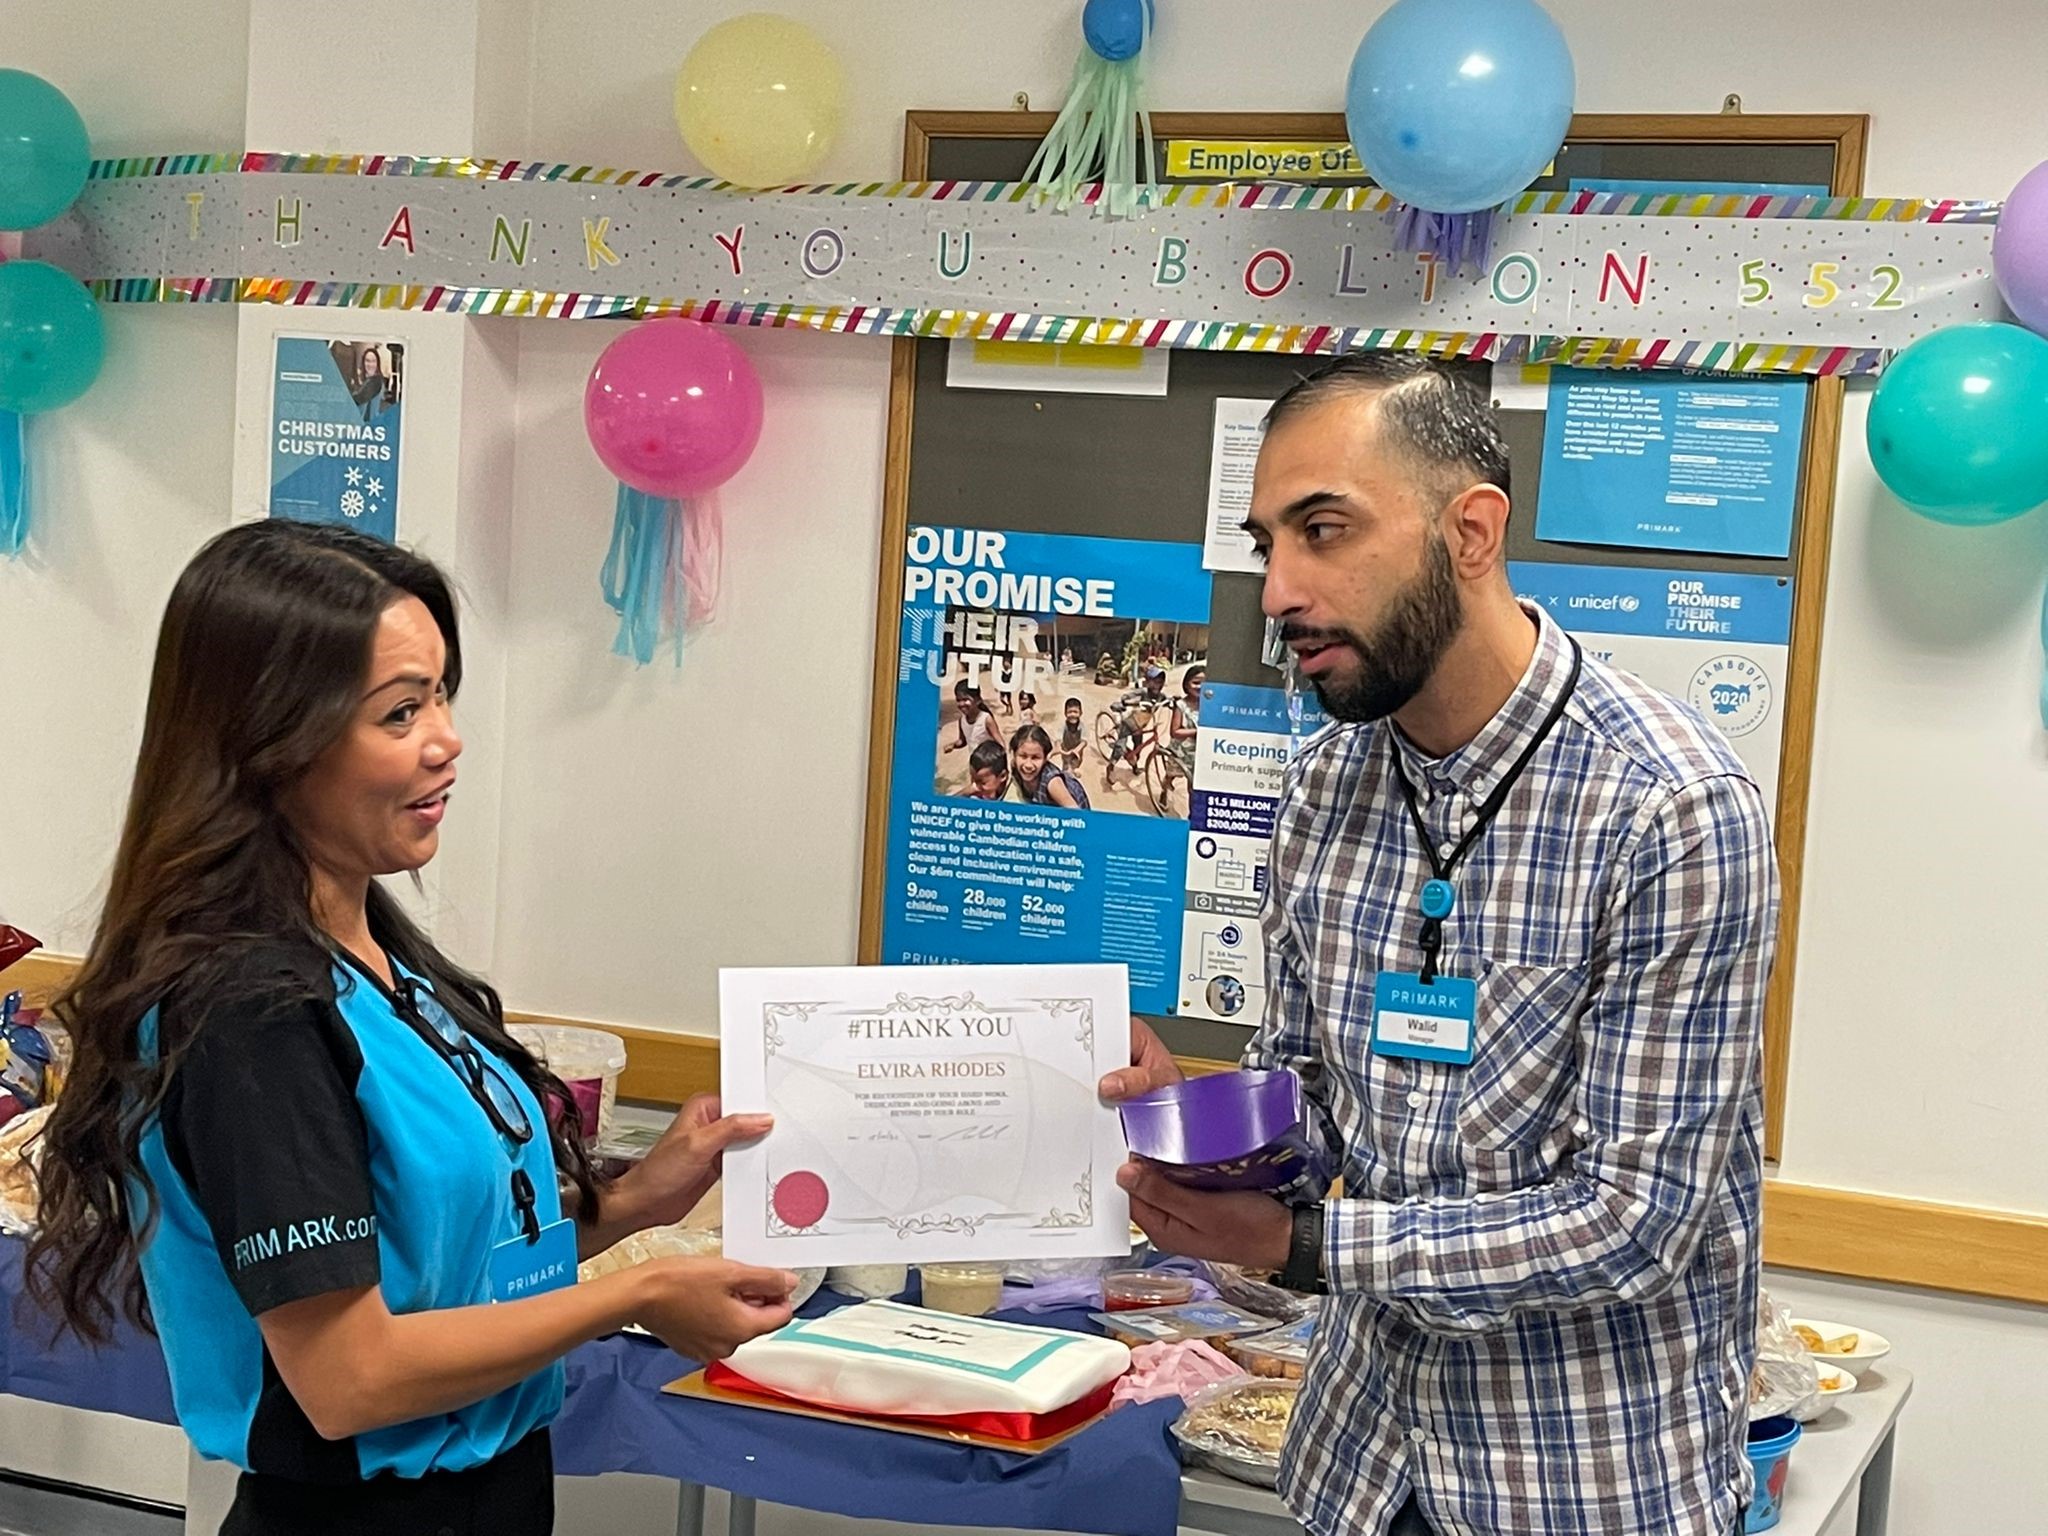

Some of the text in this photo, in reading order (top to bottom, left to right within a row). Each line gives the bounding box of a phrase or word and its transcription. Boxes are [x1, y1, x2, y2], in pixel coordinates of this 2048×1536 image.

[1189, 149, 1352, 176] Employee Of
[186, 192, 1904, 310] THANK YOU BOLTON 552
[278, 420, 386, 441] CHRISTMAS
[278, 439, 391, 461] CUSTOMERS
[1636, 522, 1682, 533] PRIMARK
[907, 526, 1007, 569] OUR
[904, 566, 1115, 617] PROMISE
[1668, 580, 1704, 594] OUR
[1569, 593, 1620, 610] unicef
[1667, 593, 1741, 609] PROMISE
[1668, 606, 1715, 621] THEIR
[904, 607, 1039, 654] THEIR
[1666, 618, 1731, 634] FUTURE
[1697, 661, 1766, 691] CAMBODIA
[1712, 690, 1749, 705] 2020
[1222, 705, 1269, 717] PRIMARK
[1213, 738, 1288, 763] Keeping
[1211, 761, 1254, 774] Primark
[1254, 780, 1265, 789] to
[1207, 796, 1271, 811] $1.5 MILLION
[911, 801, 1086, 828] We are proud to be working with
[1207, 807, 1250, 821] $300,000
[911, 815, 1064, 839] UNICEF to give thousands of
[1206, 818, 1250, 832] $200,000
[910, 827, 1076, 854] vulnerable Cambodian children
[909, 841, 1085, 868] access to an education in a safe,
[908, 852, 1084, 879] clean and inclusive environment.
[908, 863, 928, 875] Our
[956, 870, 1023, 886] commitment
[1026, 876, 1045, 888] will
[1048, 879, 1075, 893] help:
[906, 882, 938, 899] 9,000
[963, 888, 1006, 908] 28,000
[906, 900, 949, 913] children
[962, 906, 1007, 921] children
[1021, 895, 1065, 915] 52,000
[1020, 913, 1065, 928] children
[1391, 989, 1459, 1009] PRIMARK
[848, 1017, 1012, 1039] #THANK YOU
[1407, 1018, 1438, 1033] Walid
[857, 1062, 1006, 1079] ELVIRA RHODES
[507, 1261, 565, 1295] PRIMARK
